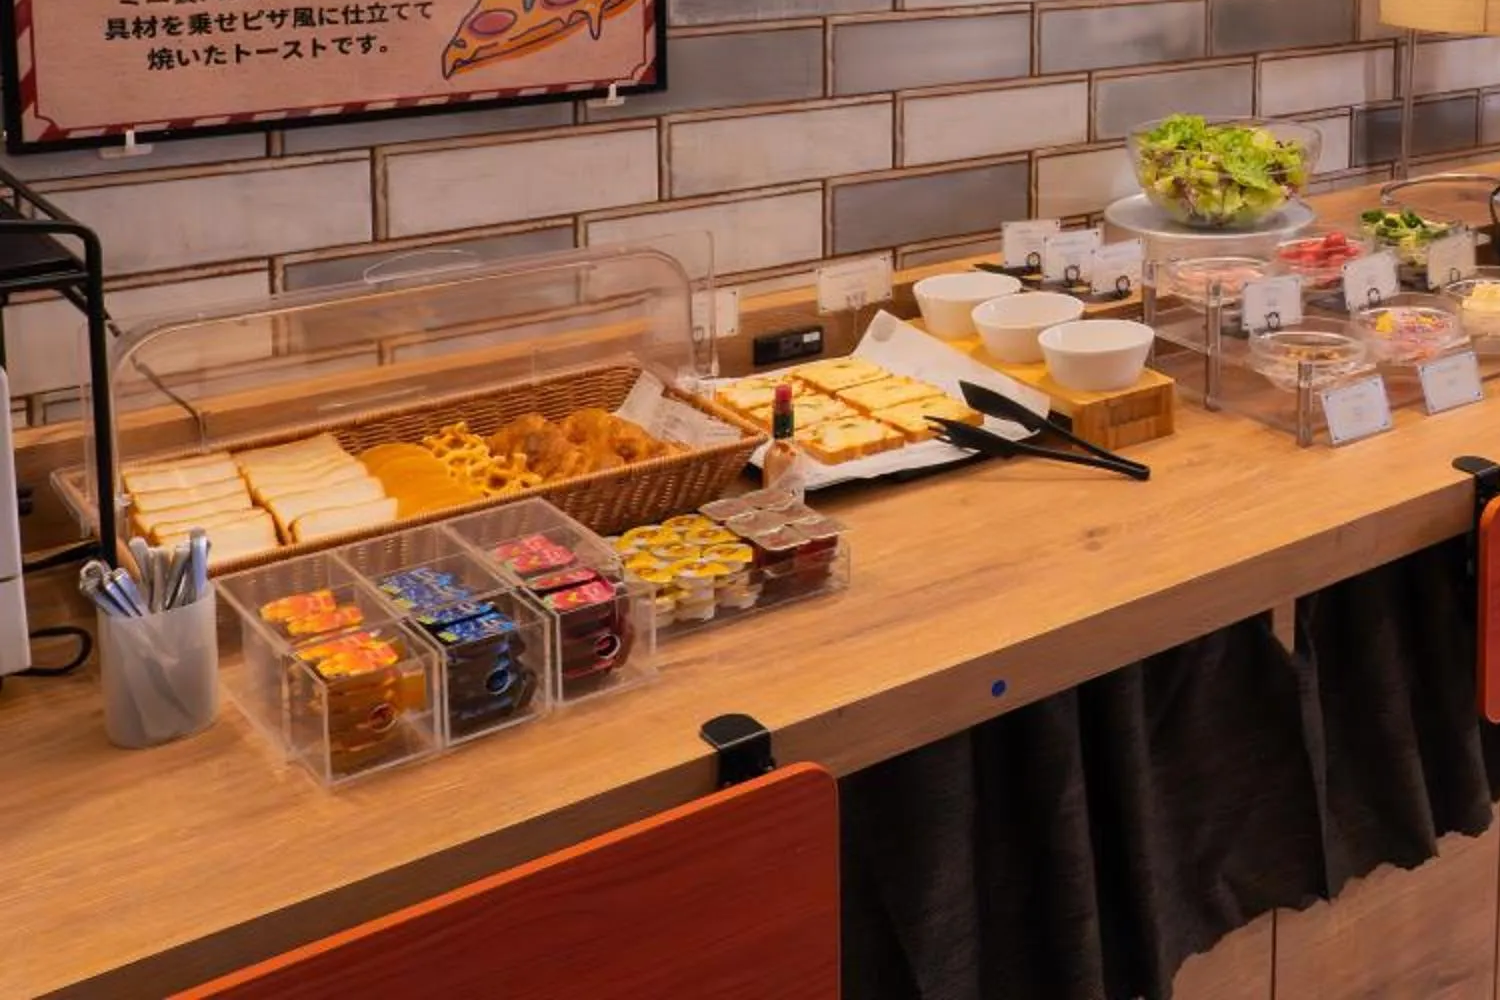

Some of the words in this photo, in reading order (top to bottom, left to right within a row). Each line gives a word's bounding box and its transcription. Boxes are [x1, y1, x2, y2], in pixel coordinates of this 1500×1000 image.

[104, 1, 434, 41] 具材を乗せピザ風に仕立てて
[147, 33, 389, 71] 焼いたトーストです。
